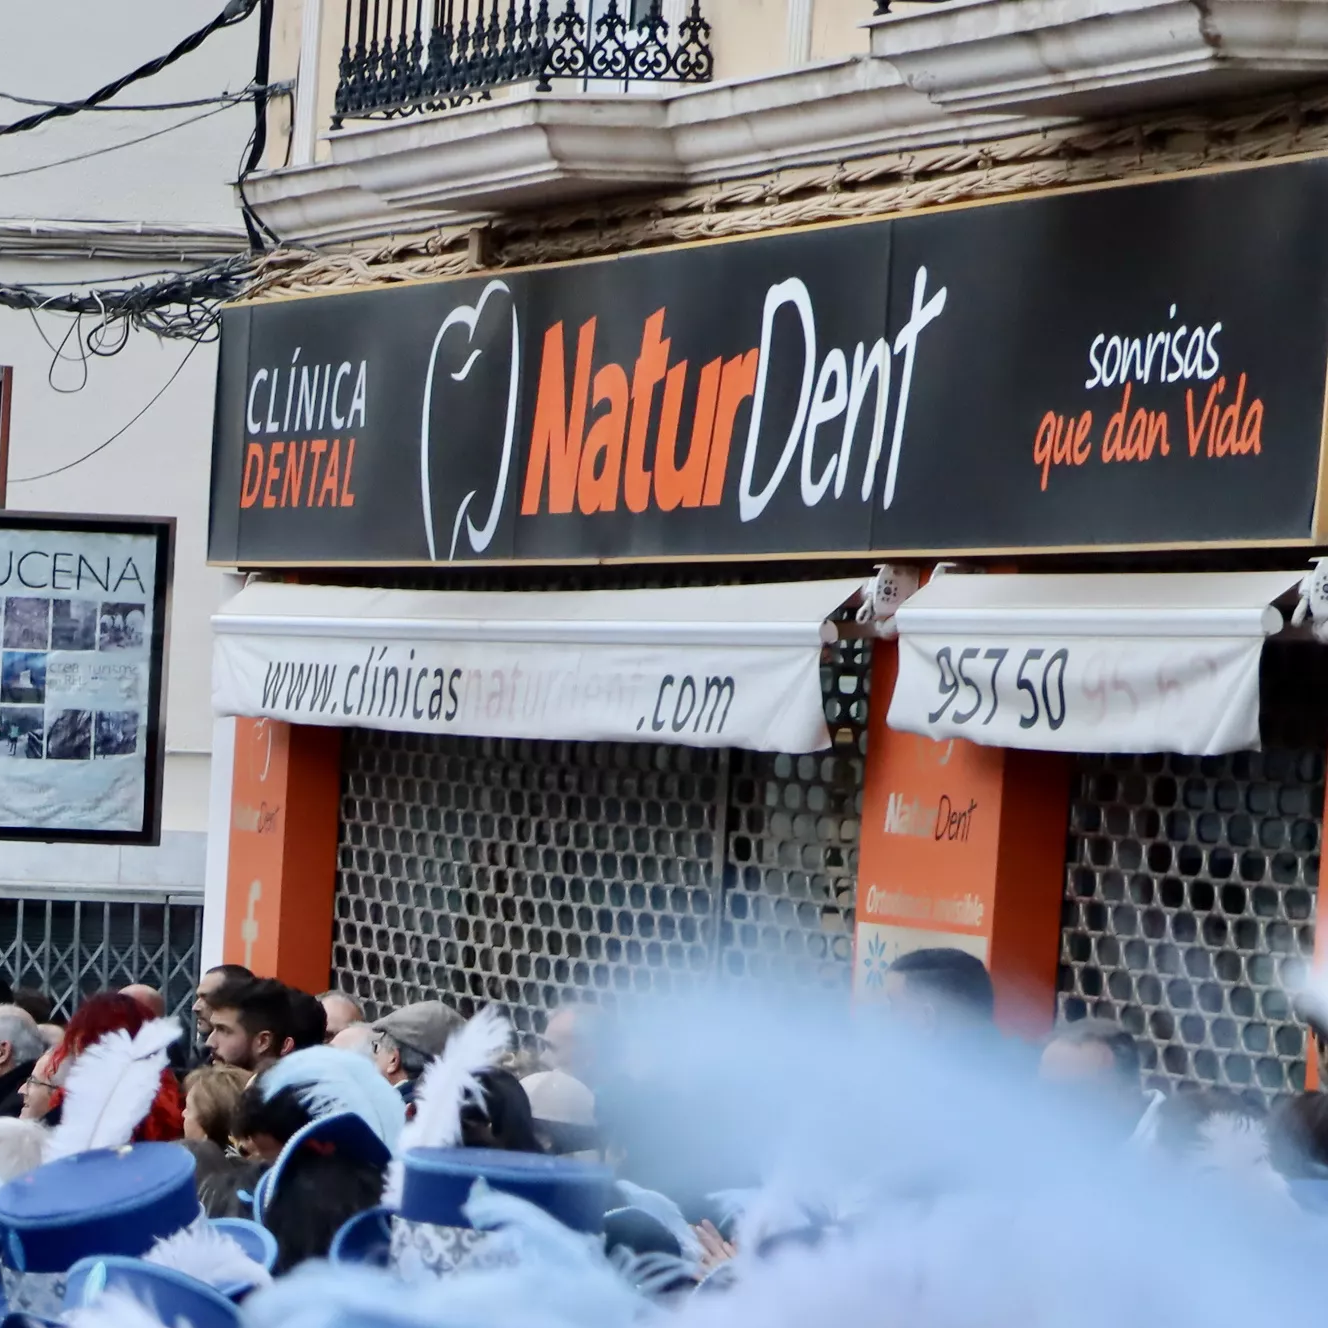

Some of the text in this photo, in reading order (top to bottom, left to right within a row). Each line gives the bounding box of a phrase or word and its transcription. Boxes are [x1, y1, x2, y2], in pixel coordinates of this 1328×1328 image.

[246, 346, 367, 435] CLÍNICA
[1084, 303, 1223, 390] sonrisas
[520, 265, 948, 523] NaturDent
[1033, 371, 1264, 491] que dan Vida
[240, 438, 356, 509] DENTAL
[928, 645, 1010, 725] 957
[1016, 647, 1069, 731] 50
